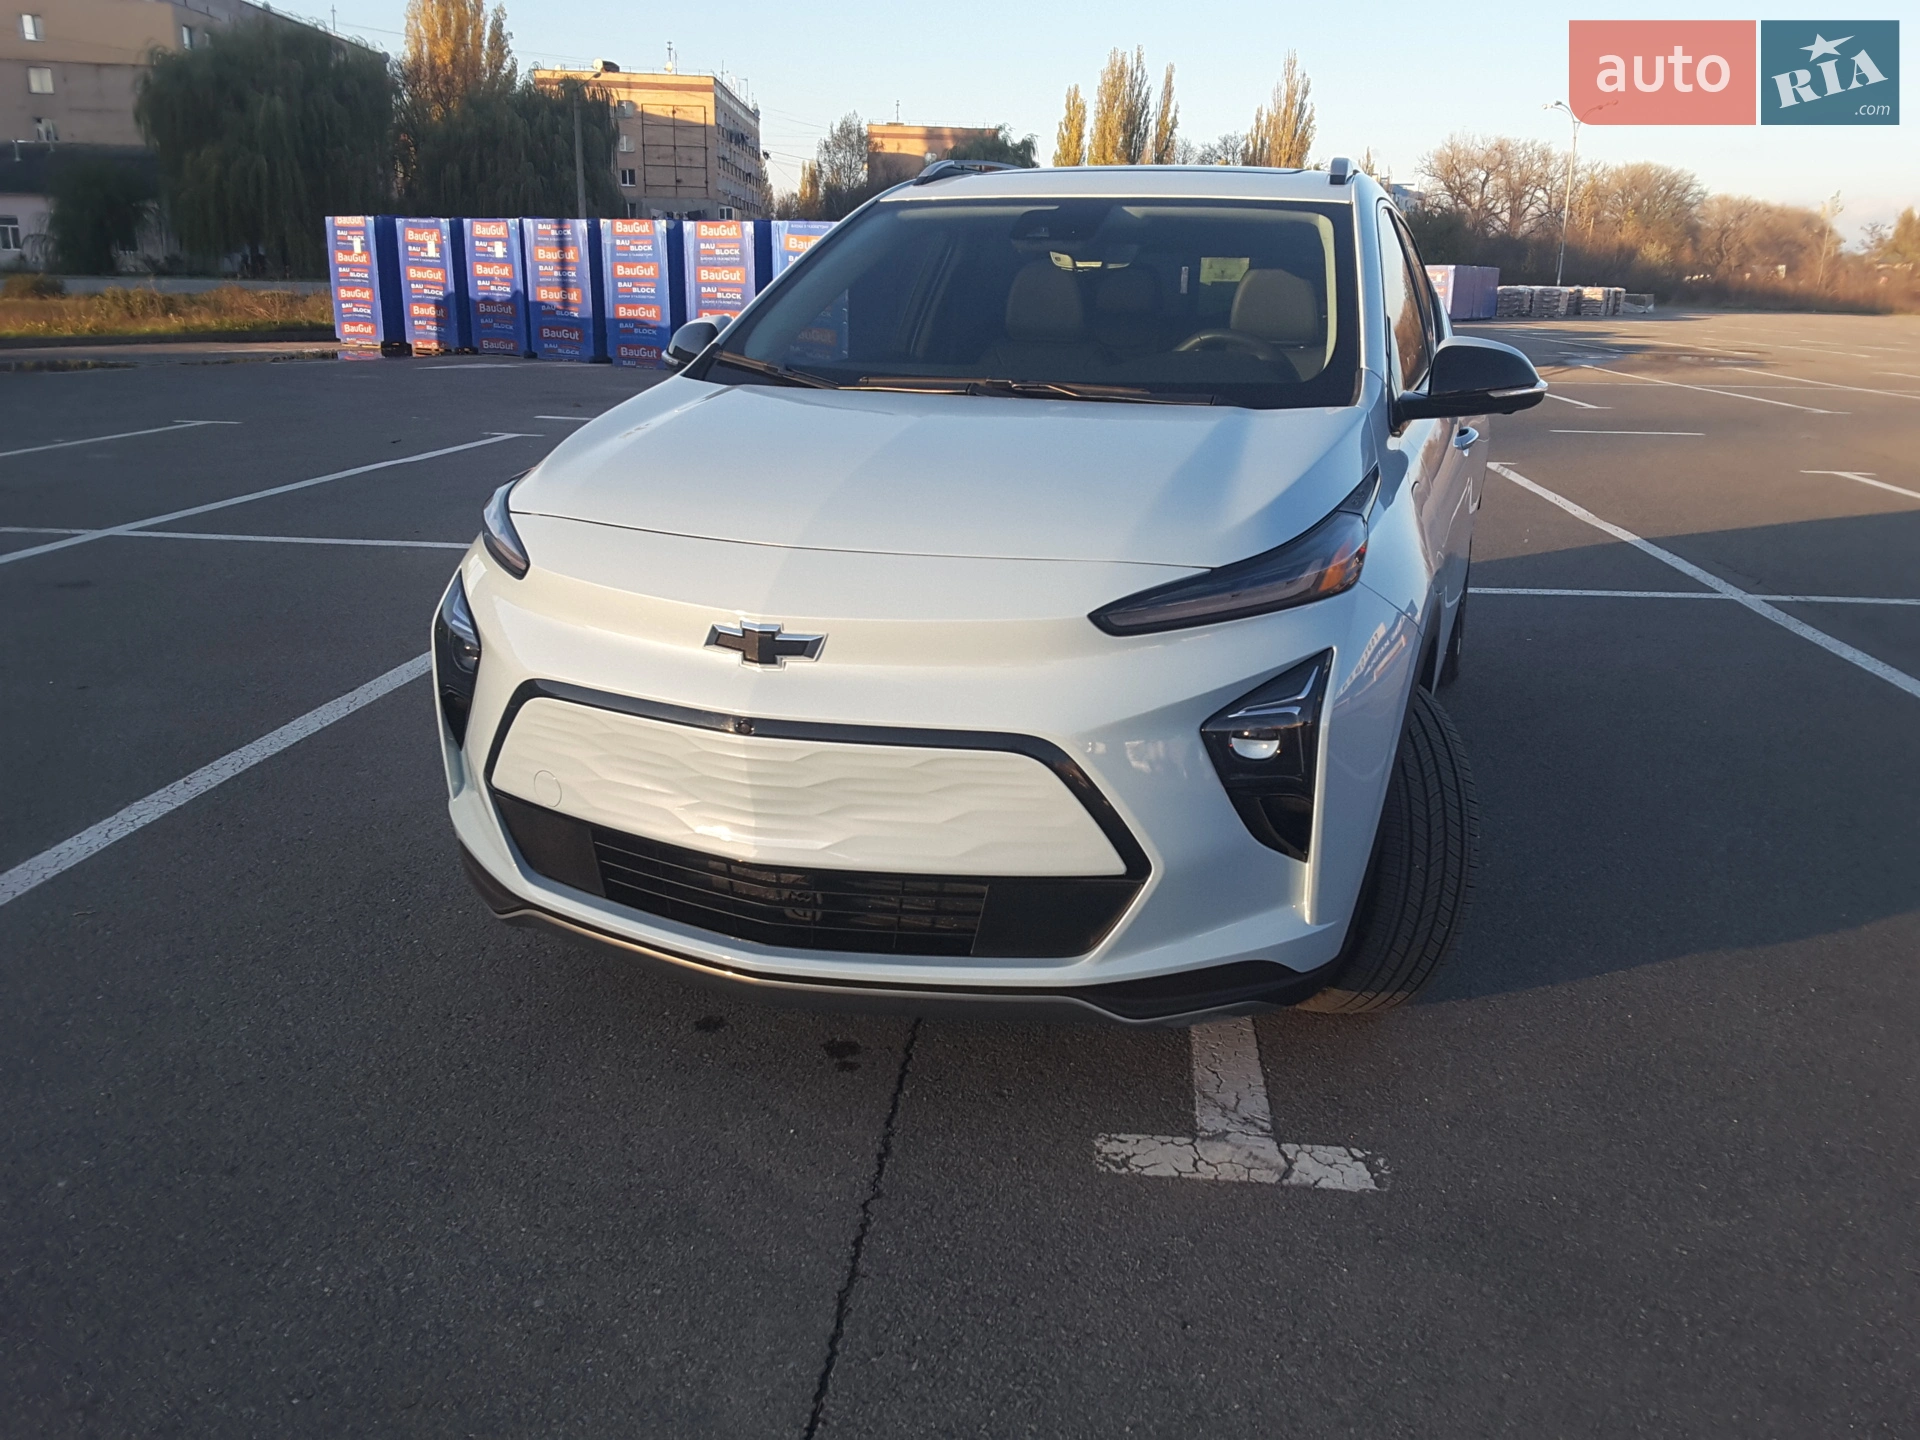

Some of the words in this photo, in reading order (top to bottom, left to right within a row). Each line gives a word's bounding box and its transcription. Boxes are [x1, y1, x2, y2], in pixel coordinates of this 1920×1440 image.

[475, 224, 504, 236] BauGut
[616, 222, 650, 233] BauGut
[700, 225, 737, 236] BauGut
[408, 230, 438, 241] BauGut
[338, 252, 367, 262] BauGut
[538, 249, 575, 260] BauGut
[410, 268, 442, 280] BauGut
[476, 264, 509, 276] BauGut
[616, 265, 654, 276] BauGut
[701, 270, 741, 280] BauGut
[340, 289, 370, 299] BauGut
[540, 290, 578, 300] BauGut
[413, 306, 444, 317] BauGut
[479, 303, 512, 314] BauGut
[618, 306, 656, 318] BauGut
[344, 324, 372, 334] BauGut
[542, 328, 579, 340] BauGut
[483, 340, 514, 350] BauGut
[620, 347, 657, 358] BauGut
